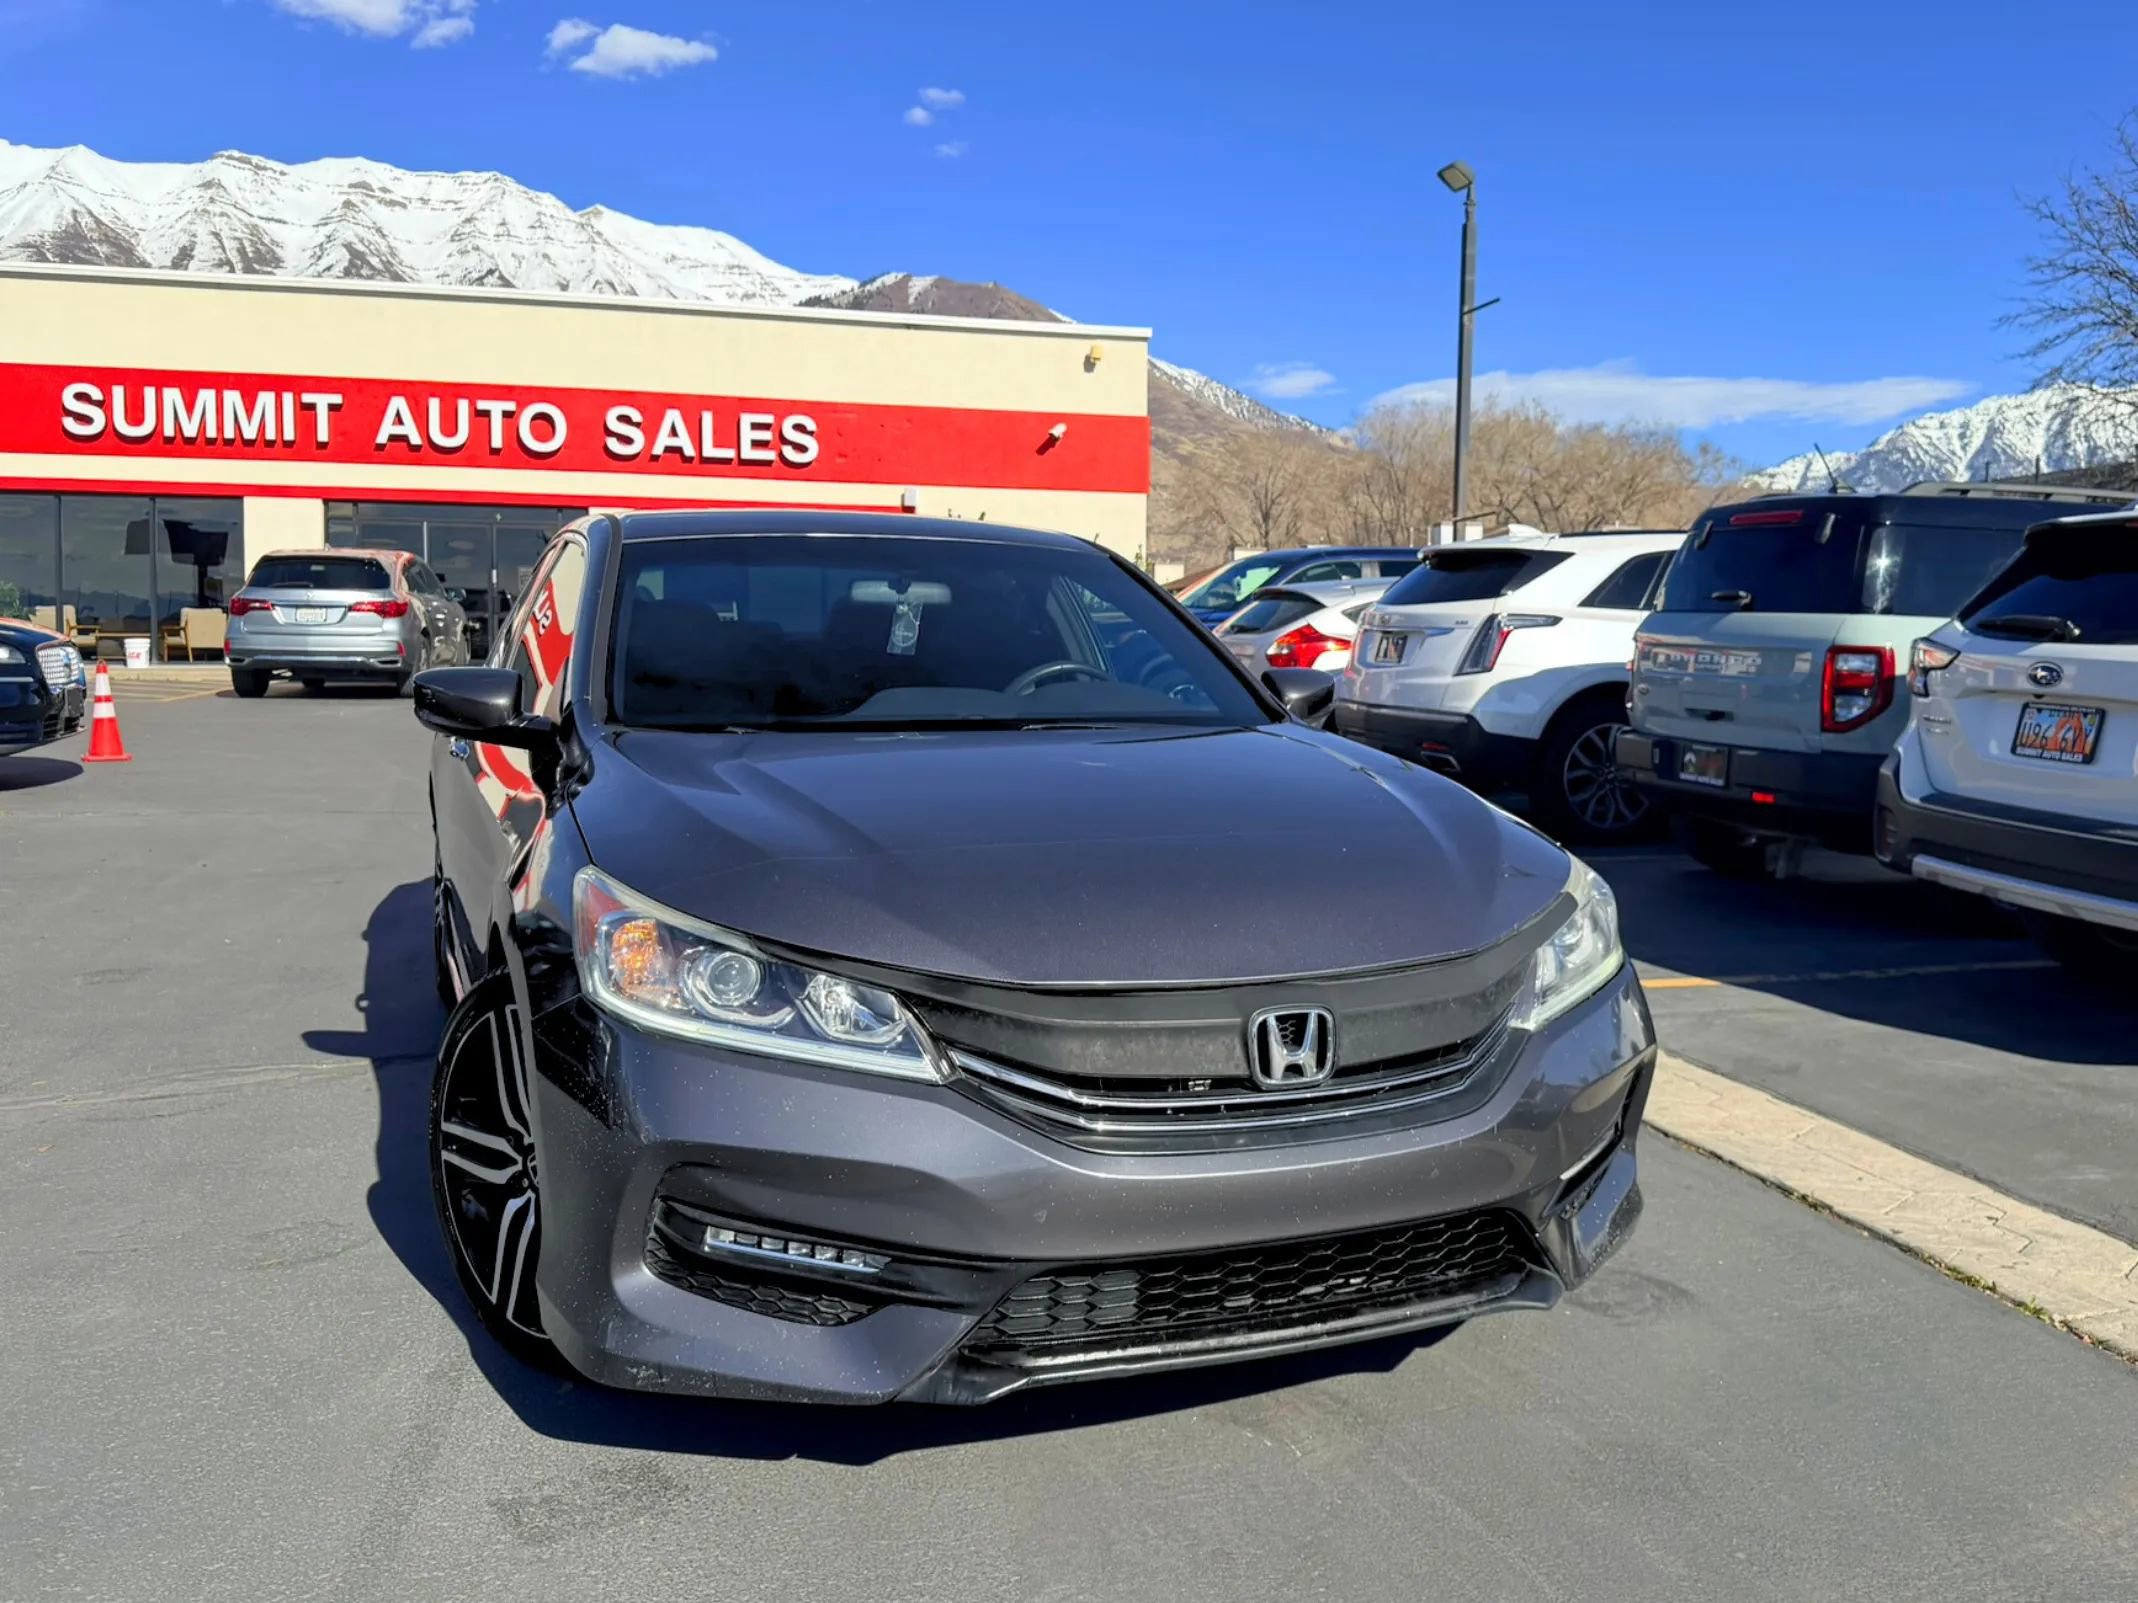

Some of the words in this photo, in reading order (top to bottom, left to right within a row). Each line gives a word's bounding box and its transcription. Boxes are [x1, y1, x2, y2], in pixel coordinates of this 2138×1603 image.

[61, 382, 343, 444] SUMMIT
[375, 395, 567, 454] AUTO
[605, 404, 819, 464] SALES
[2019, 721, 2053, 748] U96
